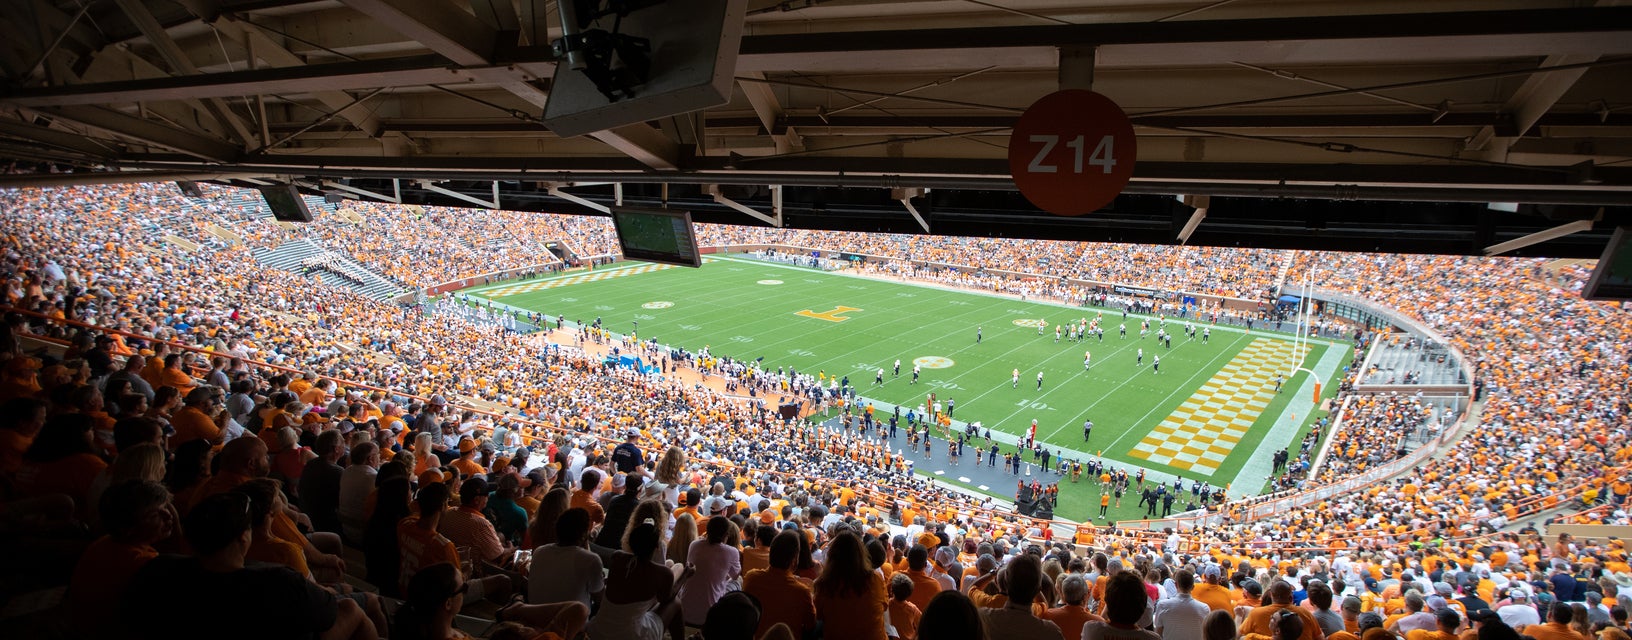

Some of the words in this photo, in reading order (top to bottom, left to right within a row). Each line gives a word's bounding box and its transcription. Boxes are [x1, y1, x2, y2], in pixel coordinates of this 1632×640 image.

[1027, 134, 1117, 174] Z14
[924, 379, 958, 390] 20
[1014, 398, 1048, 410] 10
